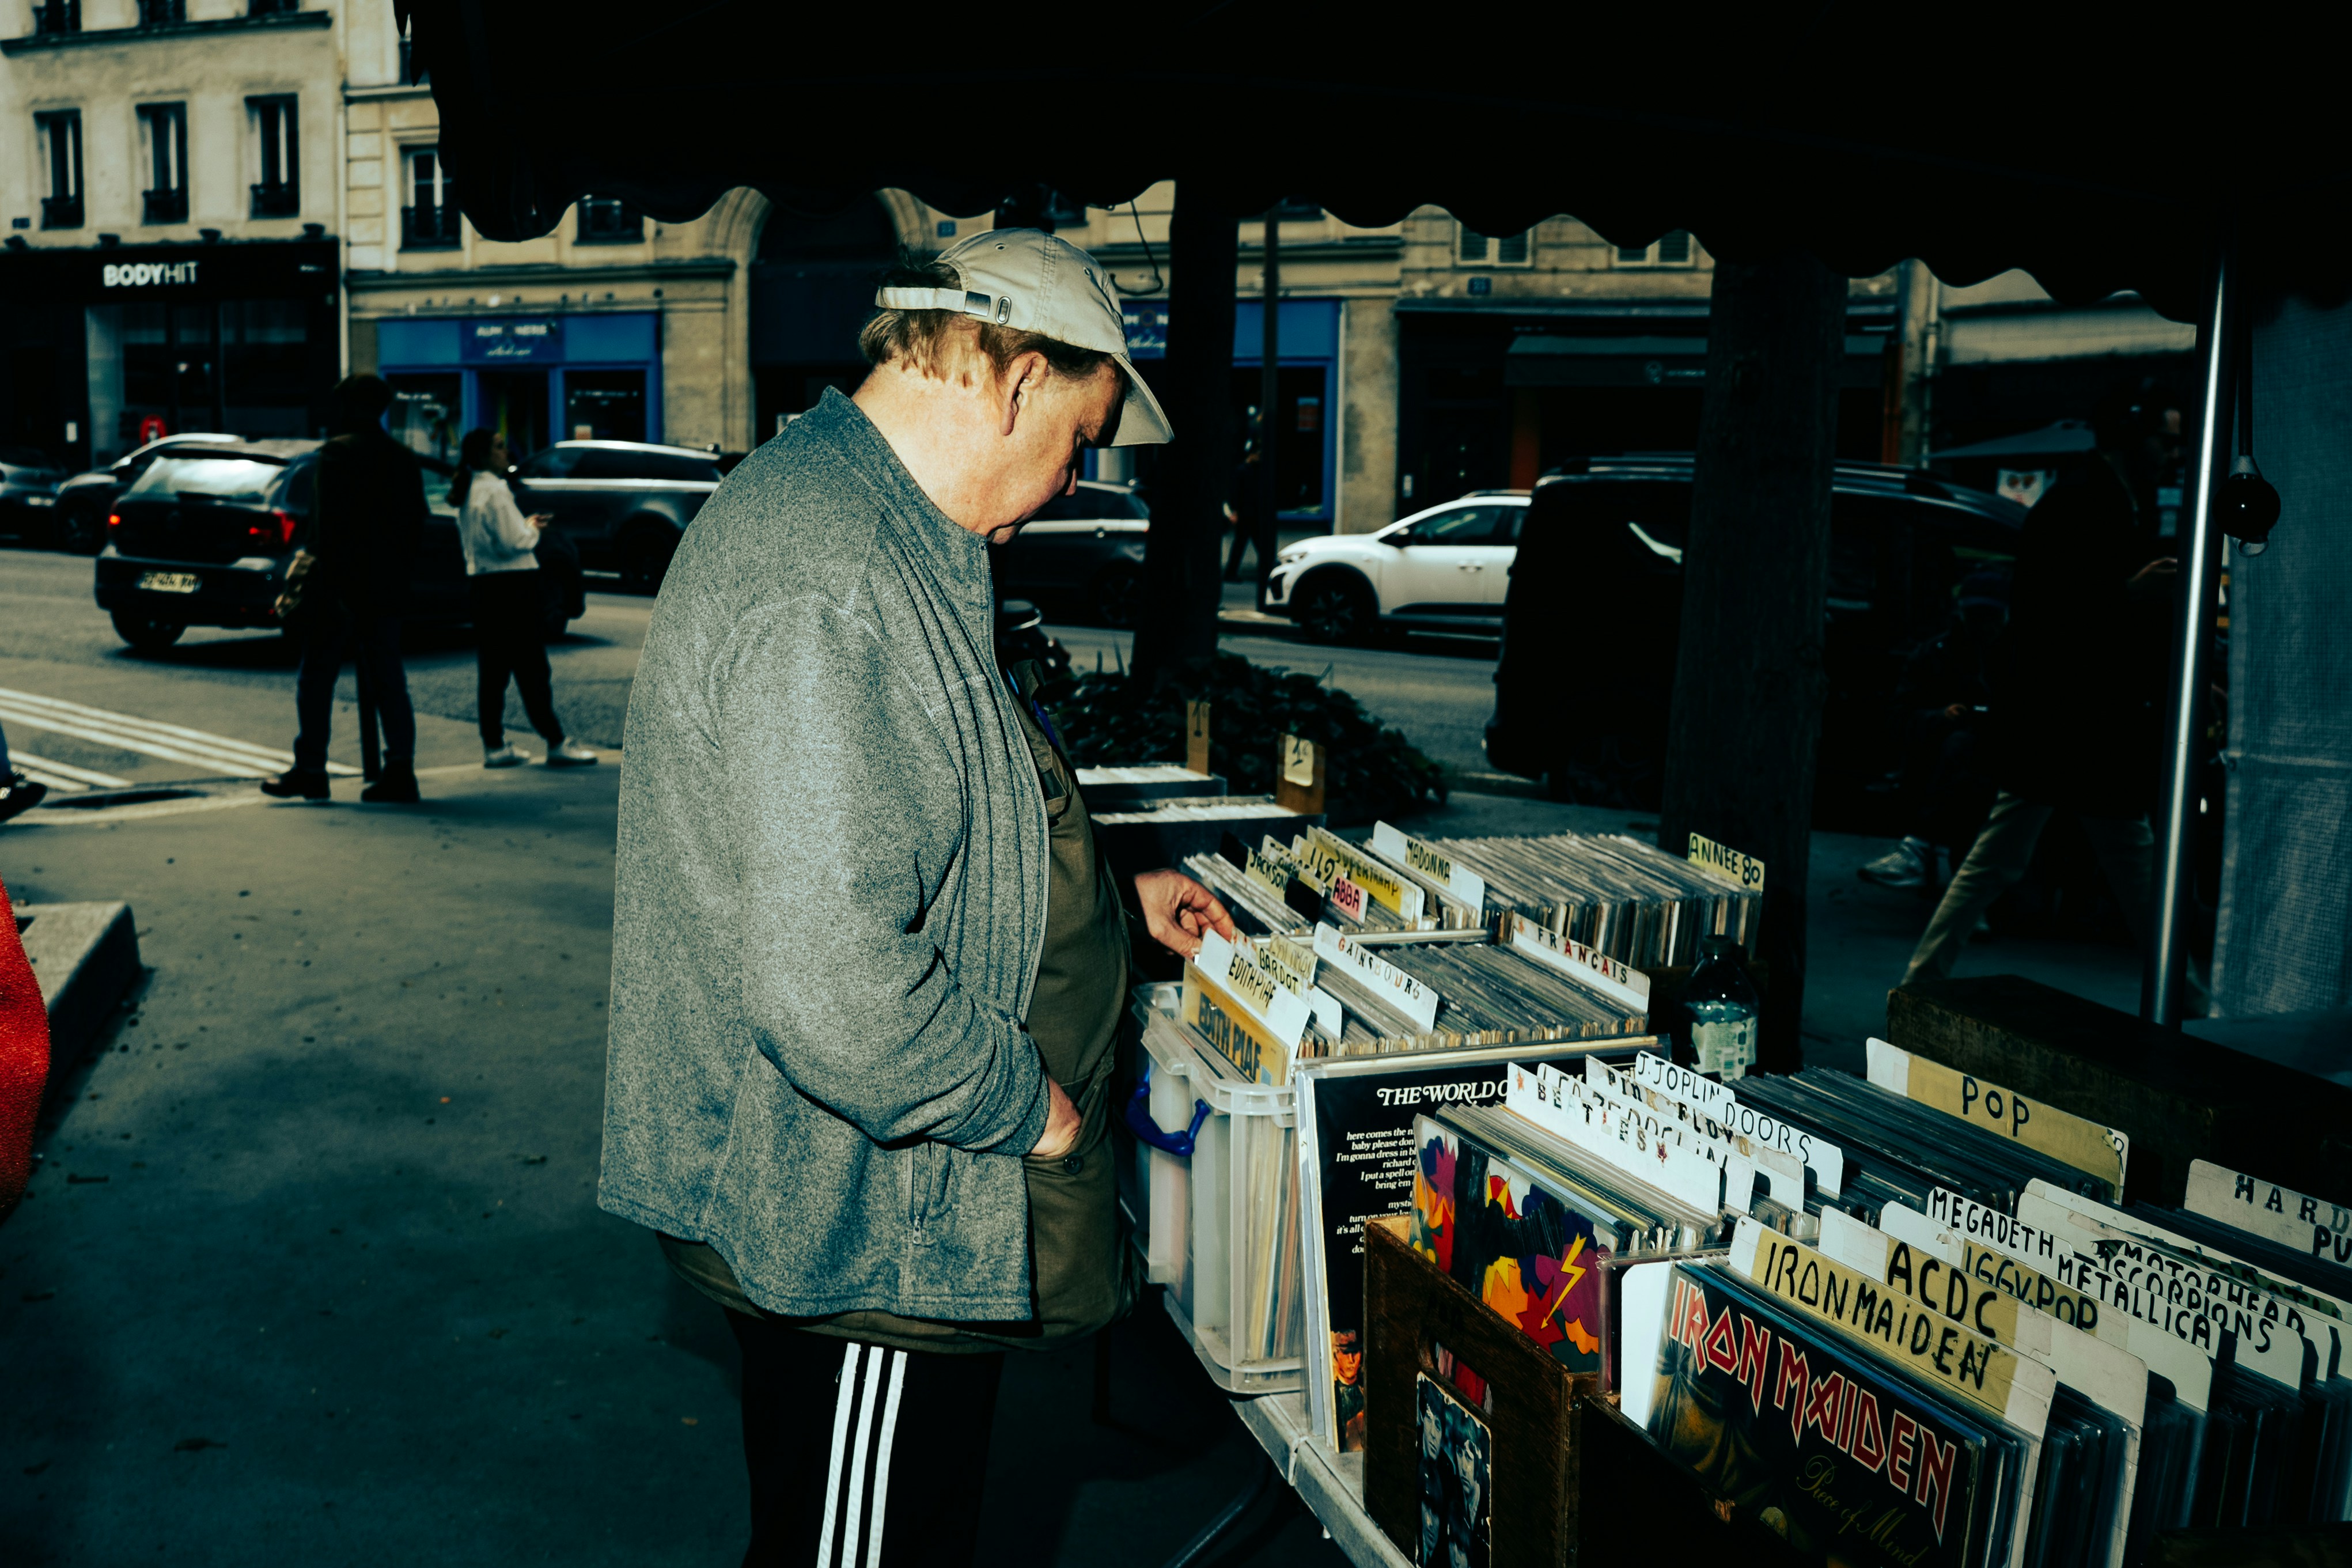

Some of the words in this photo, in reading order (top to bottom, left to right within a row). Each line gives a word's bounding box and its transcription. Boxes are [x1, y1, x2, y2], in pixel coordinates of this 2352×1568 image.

[104, 262, 197, 286] BODYHIT
[1250, 849, 1288, 891] JACKSON
[1406, 839, 1450, 883] MADONNA
[1333, 877, 1360, 912] ABBA
[1259, 948, 1298, 995] BARDOT
[1338, 937, 1421, 999] GAINSBOURG
[1538, 927, 1628, 984] FRANCAIS
[1198, 993, 1230, 1055] EDITH
[1233, 1022, 1262, 1081] PIAF
[1376, 1085, 1422, 1107] THE
[1422, 1080, 1497, 1104] WORLD
[1537, 1079, 1647, 1152] BEATLES
[1962, 1075, 2030, 1138] POP
[1336, 1153, 1352, 1162] I'm
[1351, 1152, 1378, 1163] gonna
[1377, 1149, 1398, 1159] dress
[1400, 1148, 1408, 1157] in
[1347, 1131, 1365, 1141] here
[1366, 1129, 1392, 1139] comes
[1393, 1127, 1406, 1137] the
[1351, 1141, 1370, 1152] baby
[1372, 1139, 1398, 1150] please
[1725, 1101, 1812, 1165] DOORS
[1365, 1171, 1378, 1181] put
[1385, 1169, 1403, 1180] spell
[1375, 1179, 1396, 1191] bring
[1383, 1158, 1411, 1169] richard
[1349, 1214, 1366, 1223] turn
[1933, 1189, 2054, 1259] MEGADETH
[2234, 1174, 2350, 1234] HARD
[1336, 1225, 1348, 1234] it's
[1349, 1224, 1360, 1233] all
[1887, 1242, 1998, 1338] ACDC
[2124, 1243, 2305, 1338] MOTORHEAD
[1669, 1276, 1771, 1417] IRON
[1774, 1335, 1957, 1548] MAIDEN
[1796, 1455, 1839, 1512] Piece
[1838, 1500, 1873, 1535] of
[1856, 1506, 1930, 1568] Mind
